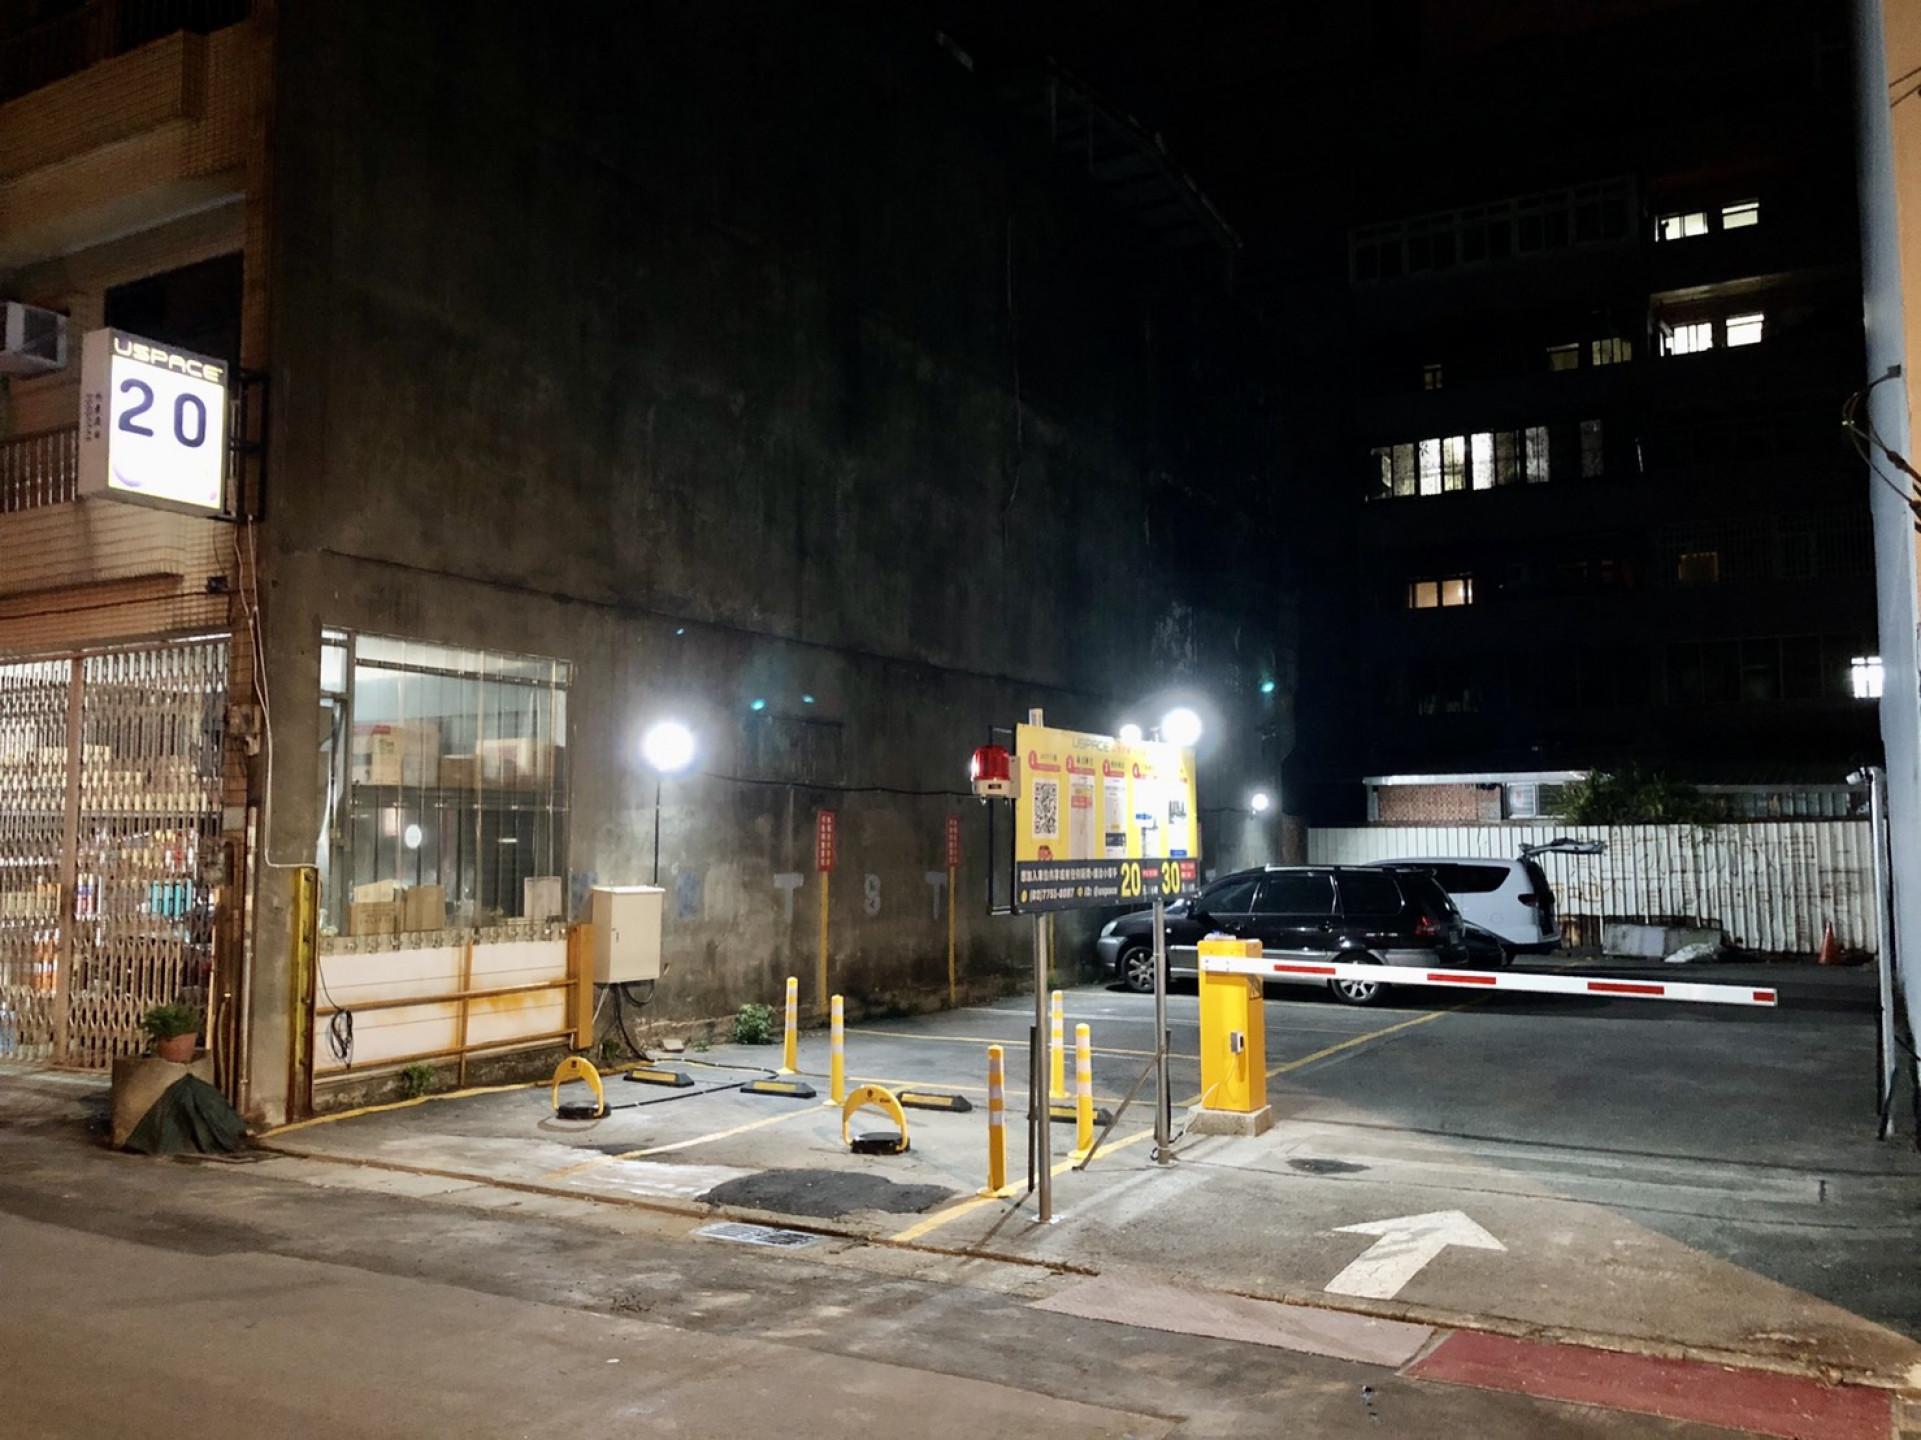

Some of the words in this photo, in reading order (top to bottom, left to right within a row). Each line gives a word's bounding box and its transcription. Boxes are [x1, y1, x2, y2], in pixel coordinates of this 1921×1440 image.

[114, 337, 224, 383] USPACE
[118, 378, 207, 448] 20
[1121, 862, 1141, 897] 20
[1161, 861, 1180, 895] 30
